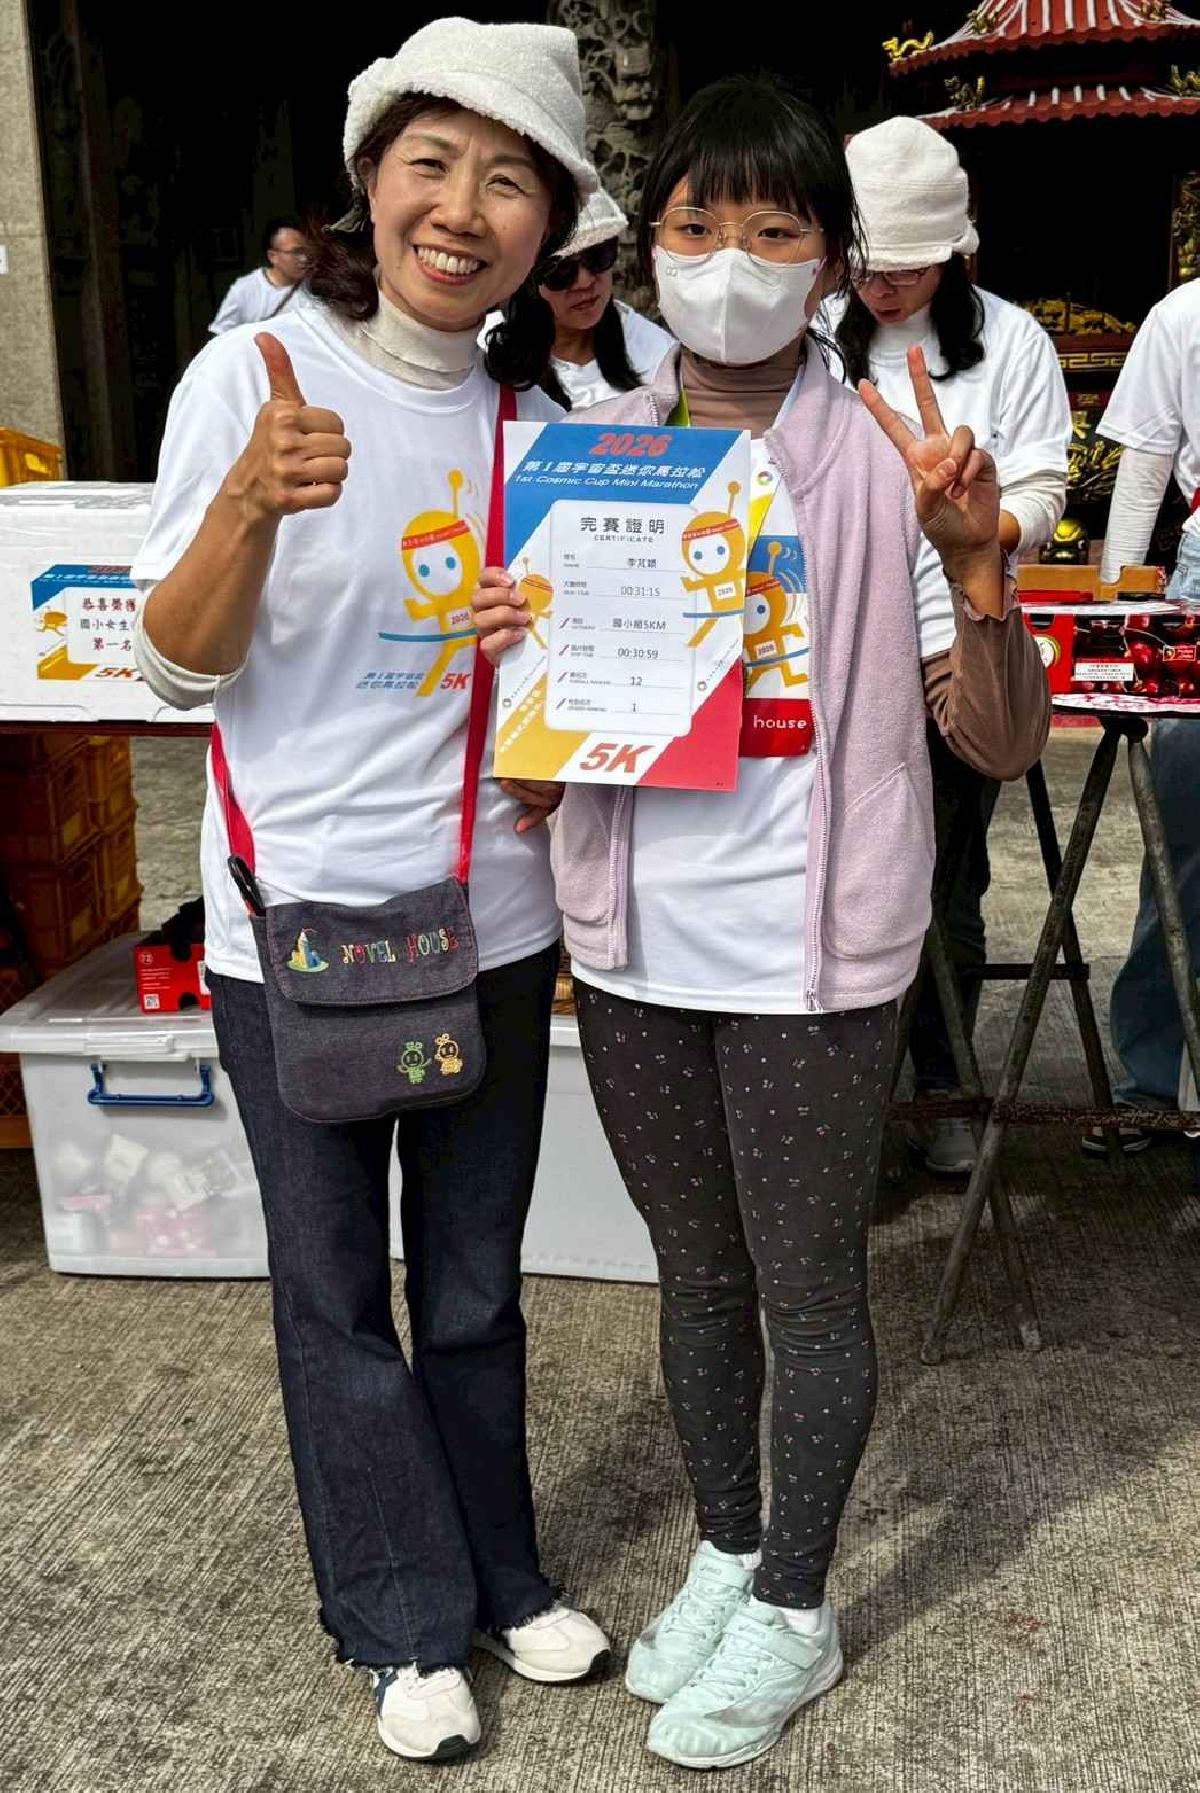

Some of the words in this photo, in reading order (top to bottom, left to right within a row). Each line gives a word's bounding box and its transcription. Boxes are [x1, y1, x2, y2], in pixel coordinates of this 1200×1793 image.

[588, 432, 672, 457] 2026
[584, 477, 610, 487] Cup
[611, 478, 638, 487] Mini
[640, 479, 699, 490] Marathon
[580, 517, 665, 535] 完賽證明
[440, 672, 471, 690] 5K
[630, 676, 642, 686] 12
[753, 714, 807, 729] house
[579, 742, 656, 773] 5K
[340, 940, 396, 964] NOVEL
